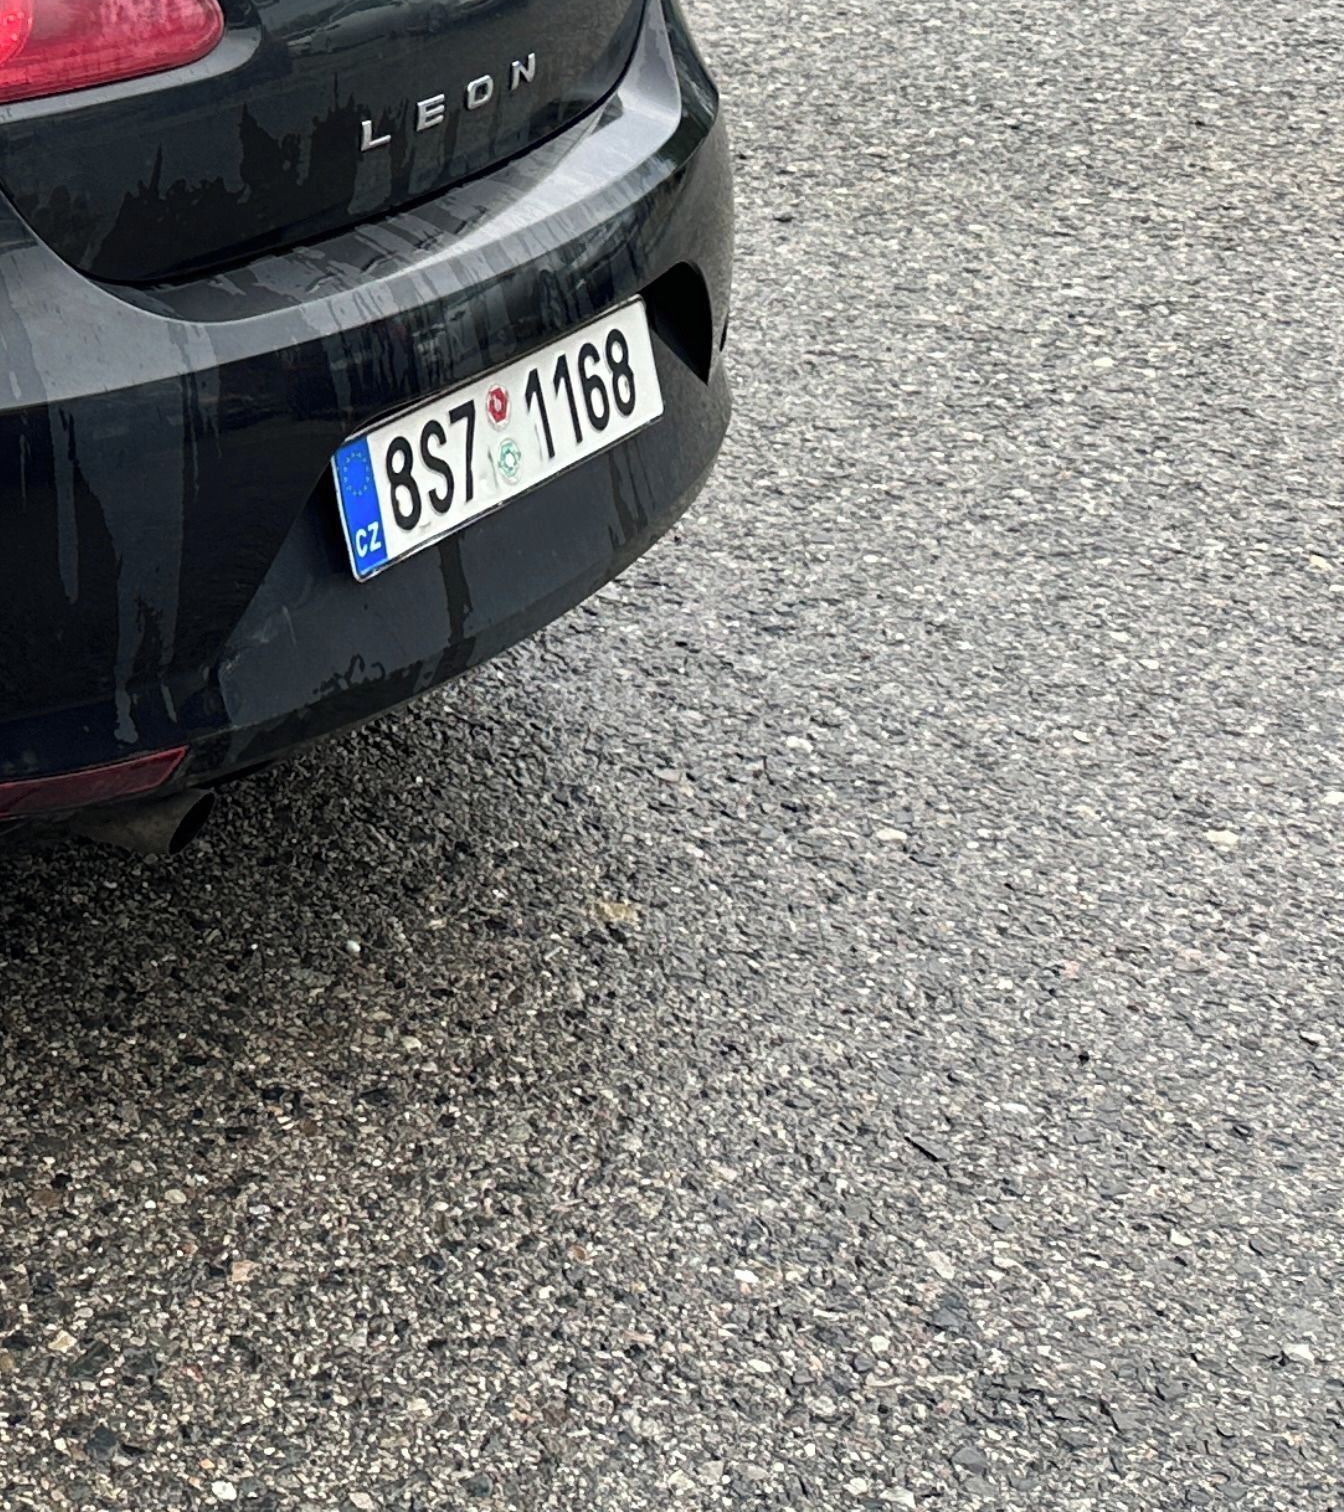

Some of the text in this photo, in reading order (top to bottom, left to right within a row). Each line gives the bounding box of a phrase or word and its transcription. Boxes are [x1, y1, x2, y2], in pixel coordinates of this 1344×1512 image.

[361, 52, 537, 152] LEON
[355, 328, 636, 558] CZ 8S7 1168
